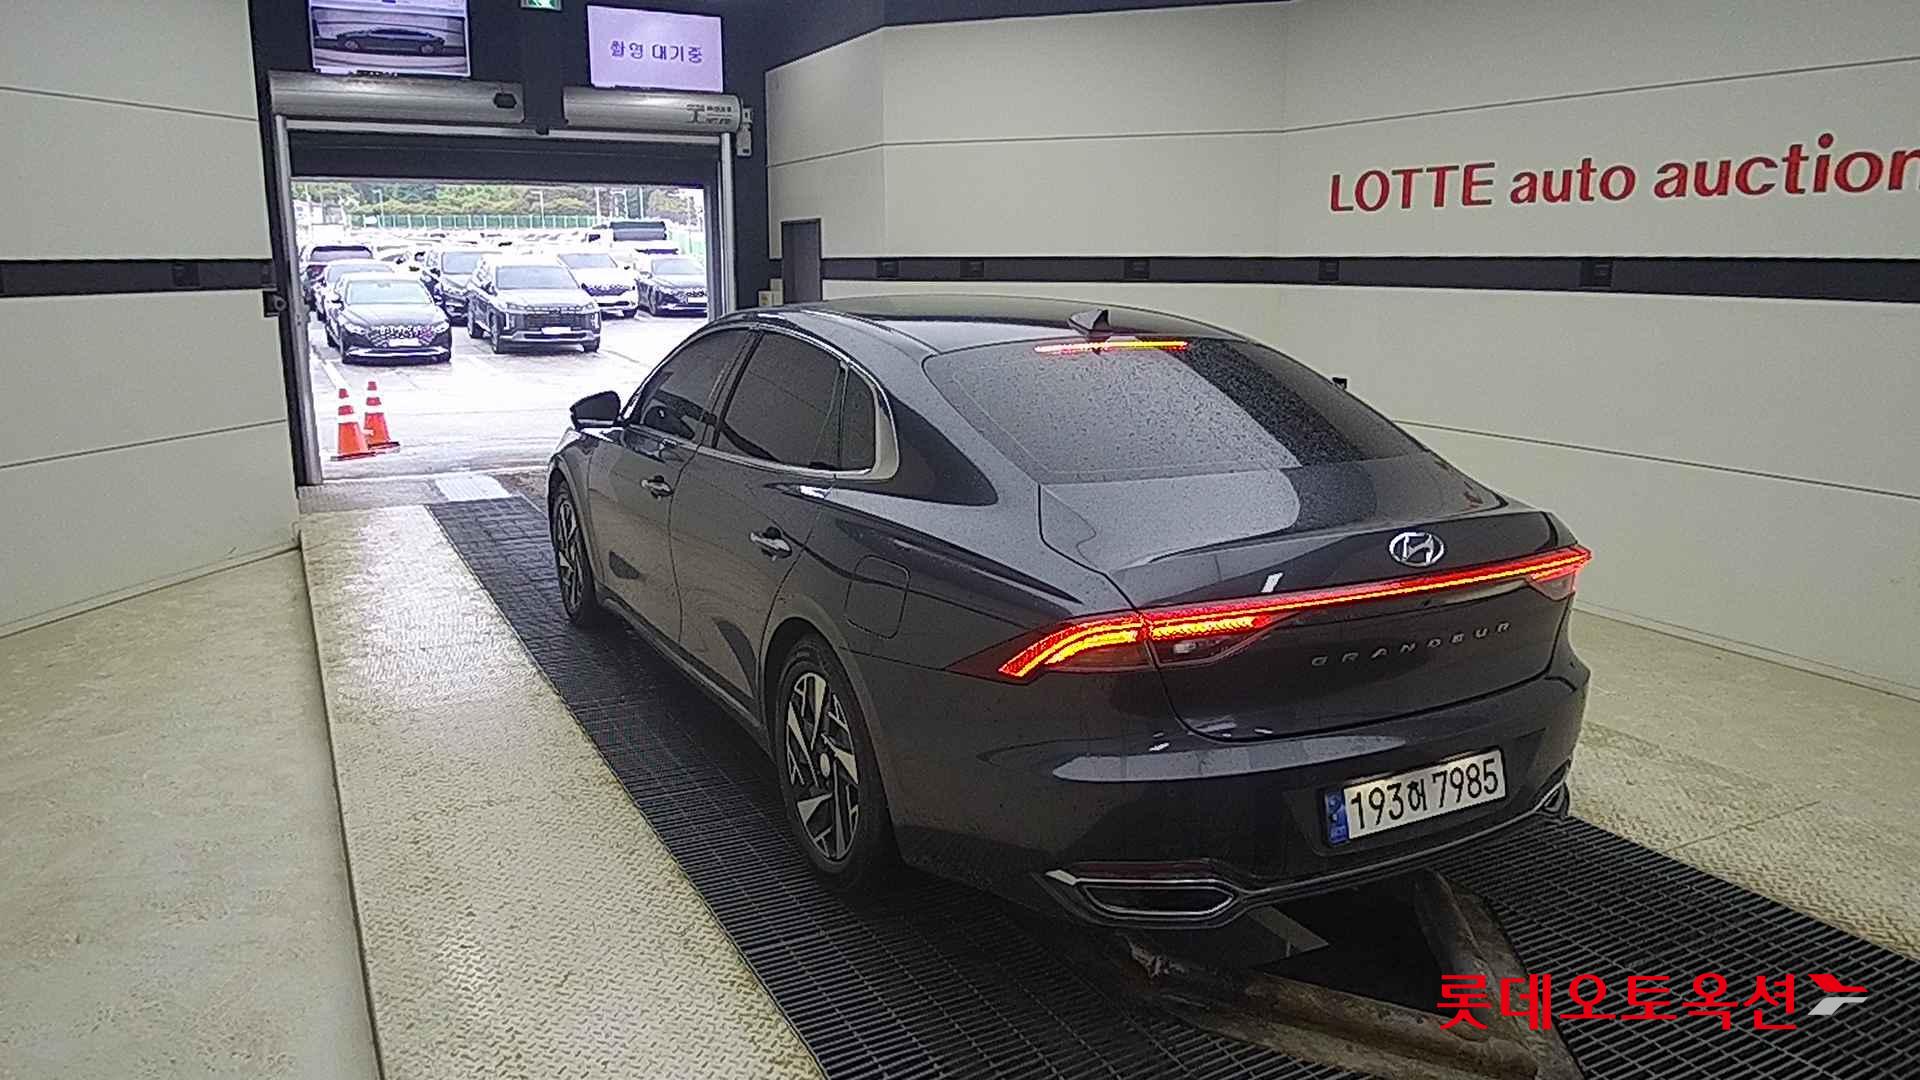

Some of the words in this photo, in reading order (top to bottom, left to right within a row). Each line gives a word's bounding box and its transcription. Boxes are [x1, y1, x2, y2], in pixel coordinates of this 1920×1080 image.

[651, 45, 703, 64] 대기중
[1330, 162, 1495, 212] LOTTE
[1510, 157, 1637, 205] auto
[1311, 621, 1511, 666] GRANDEUR
